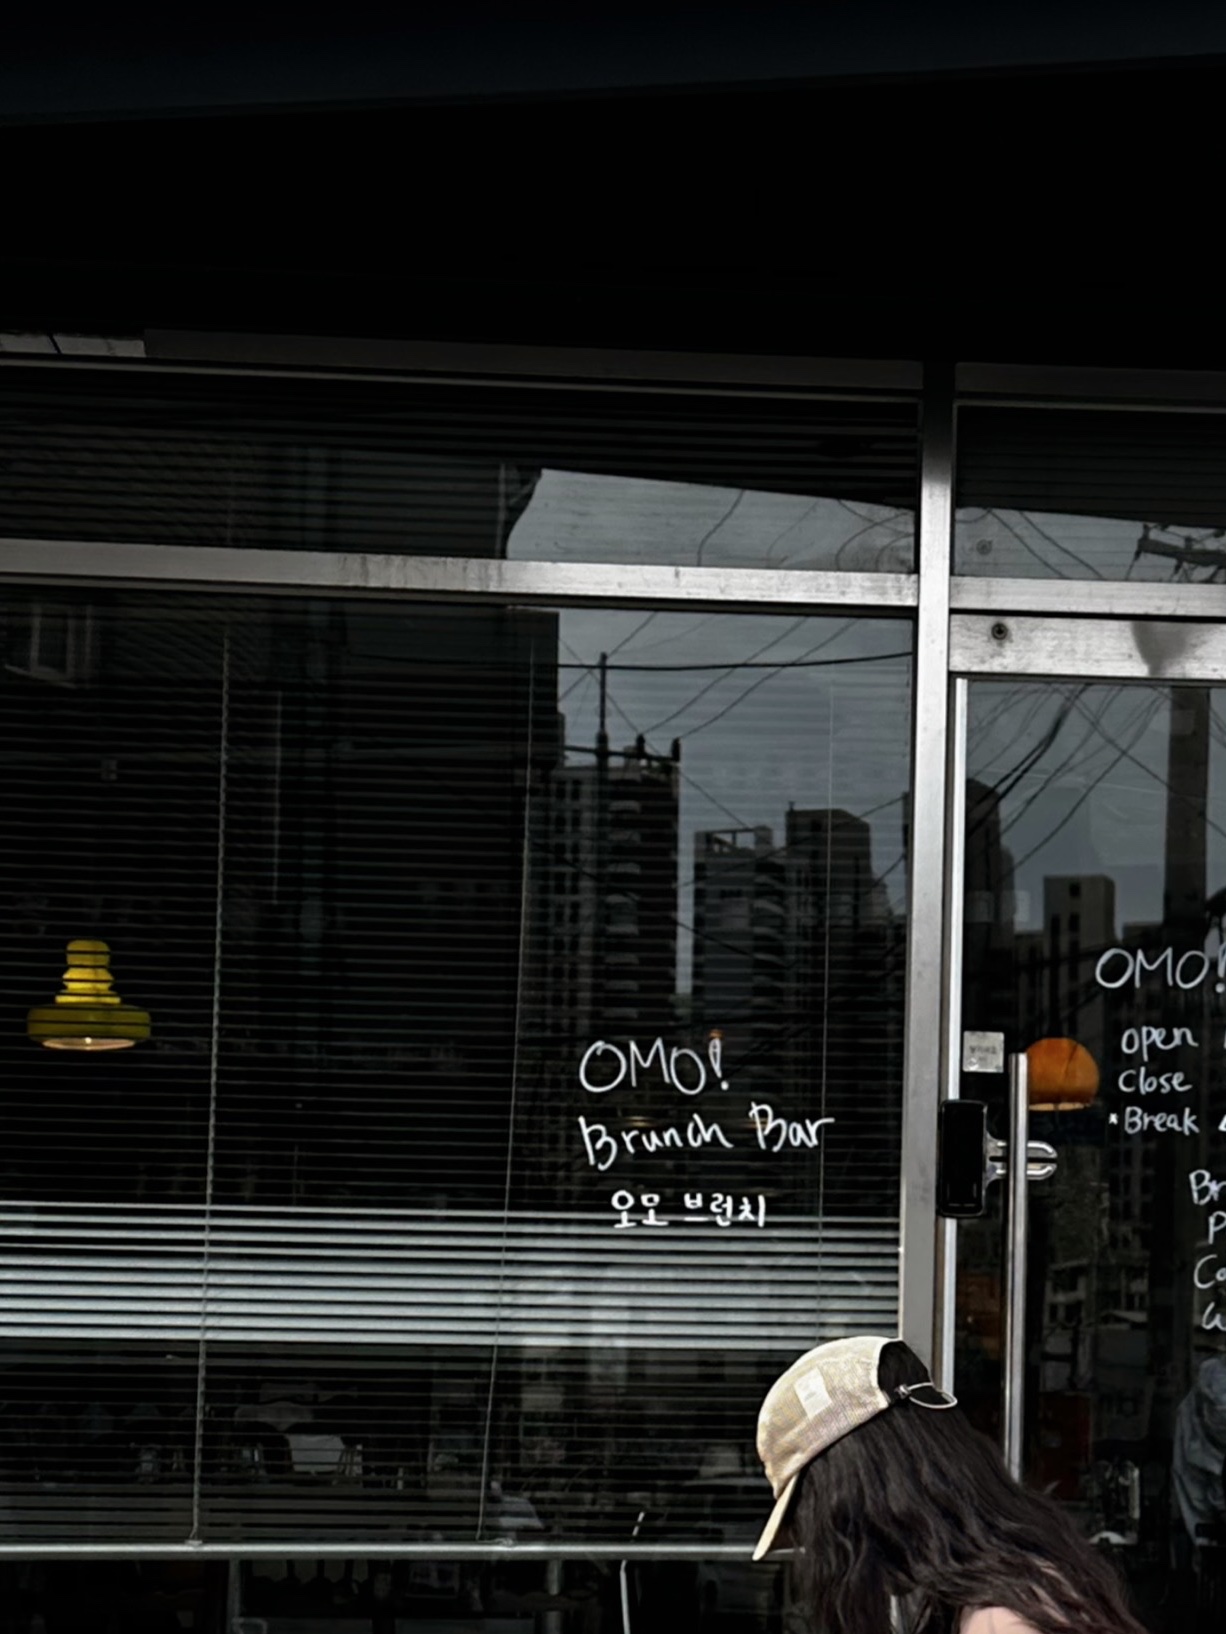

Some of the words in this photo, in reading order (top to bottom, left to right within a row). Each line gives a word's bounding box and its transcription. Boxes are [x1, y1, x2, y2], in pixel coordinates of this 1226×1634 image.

[579, 1036, 729, 1095] OMO!
[578, 1113, 734, 1171] Brunch
[749, 1102, 836, 1152] Bar
[611, 1190, 669, 1228] 오모
[683, 1192, 766, 1228] 브런치
